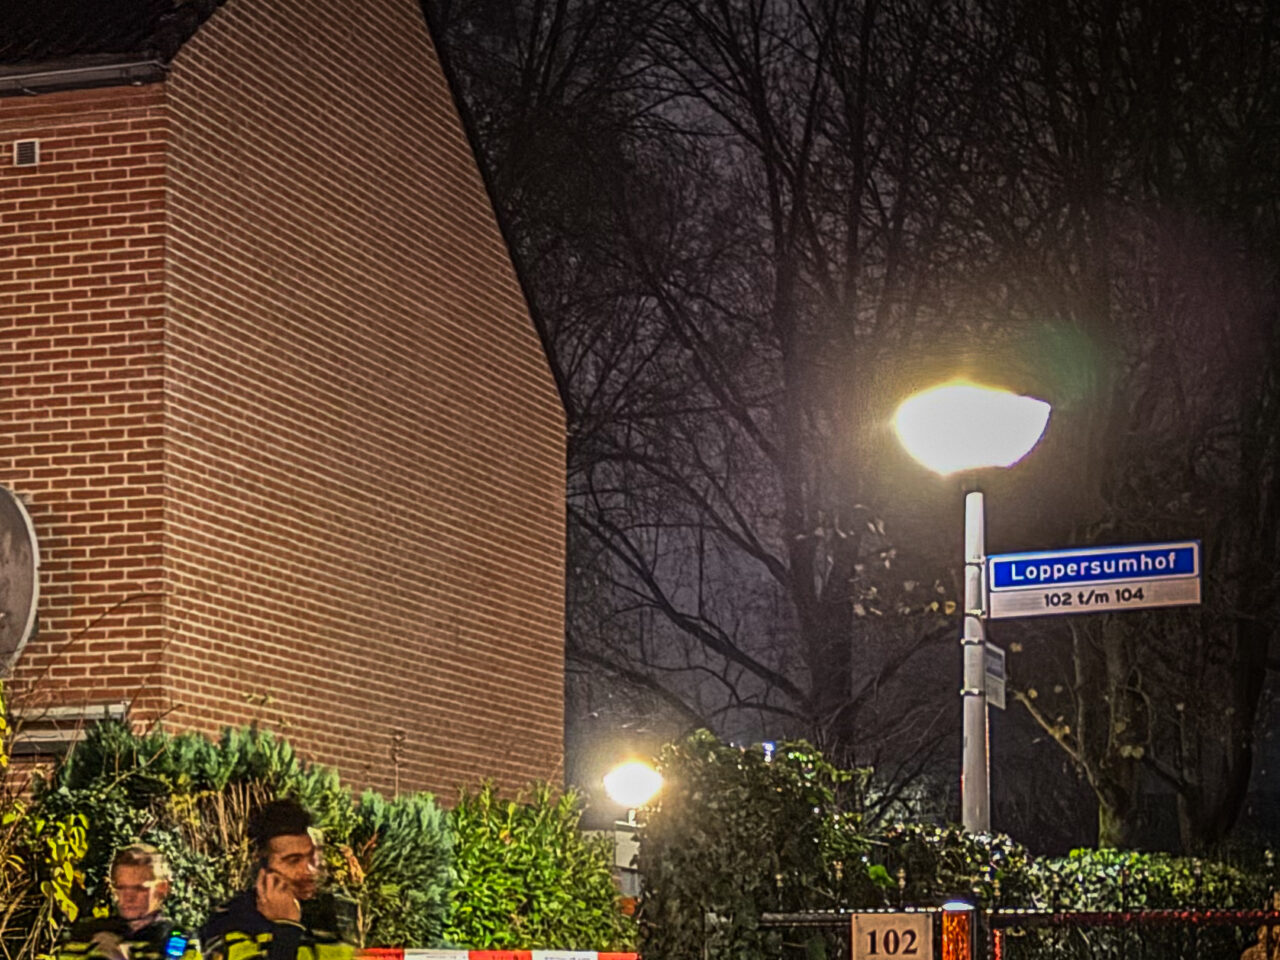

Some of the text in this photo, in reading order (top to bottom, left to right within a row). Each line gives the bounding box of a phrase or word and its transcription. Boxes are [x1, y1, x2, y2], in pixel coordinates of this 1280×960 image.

[1011, 552, 1176, 581] Loppersumhof
[1044, 587, 1144, 607] 102 t/m 104
[866, 929, 918, 955] 102
